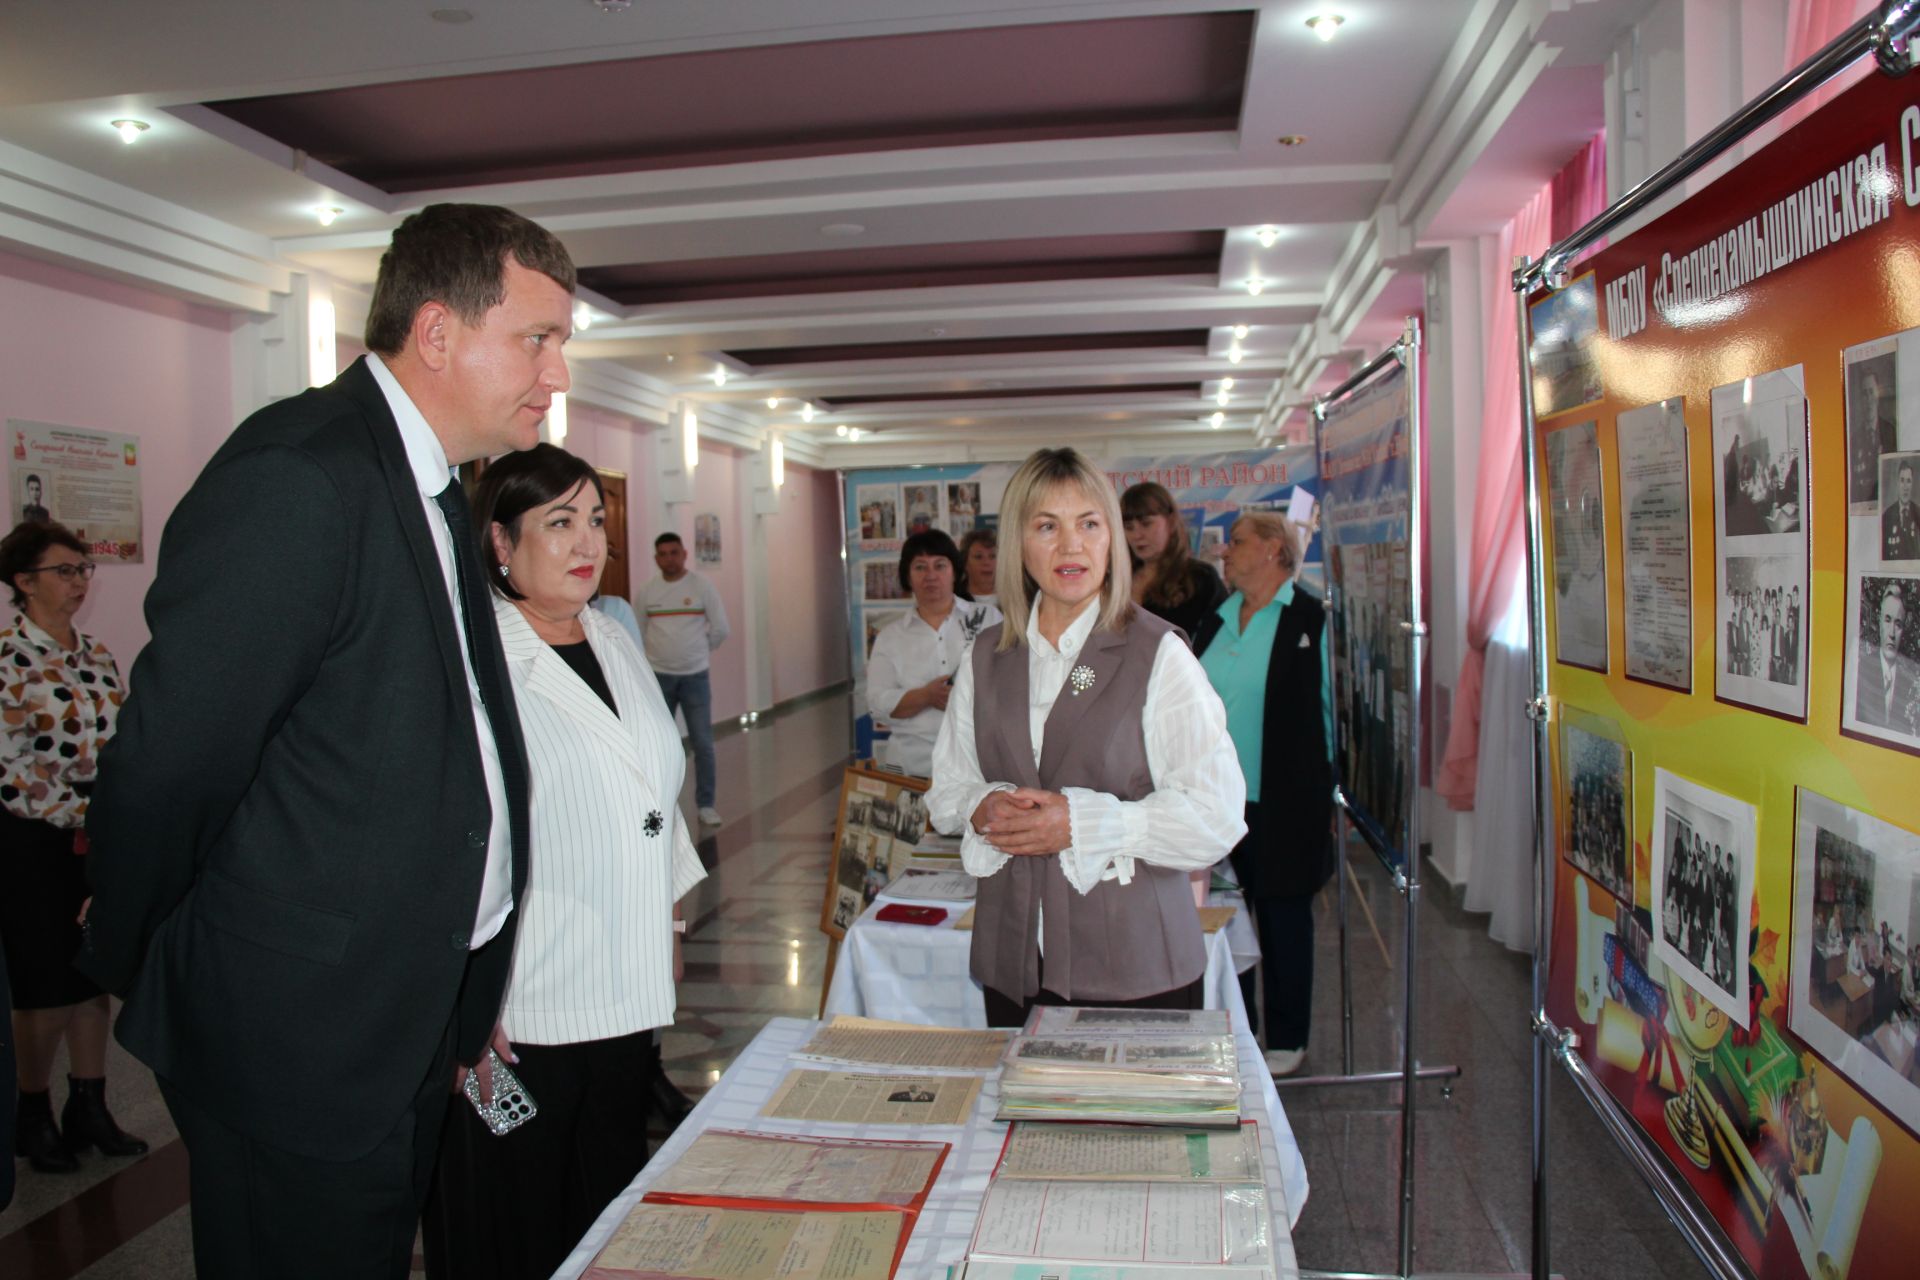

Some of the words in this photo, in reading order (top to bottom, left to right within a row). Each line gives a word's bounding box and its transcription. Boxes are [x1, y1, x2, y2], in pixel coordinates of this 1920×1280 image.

[1605, 265, 1647, 341] МБОУ
[1106, 464, 1193, 490] ТСКИЙ
[1200, 461, 1290, 487] РАЙОН
